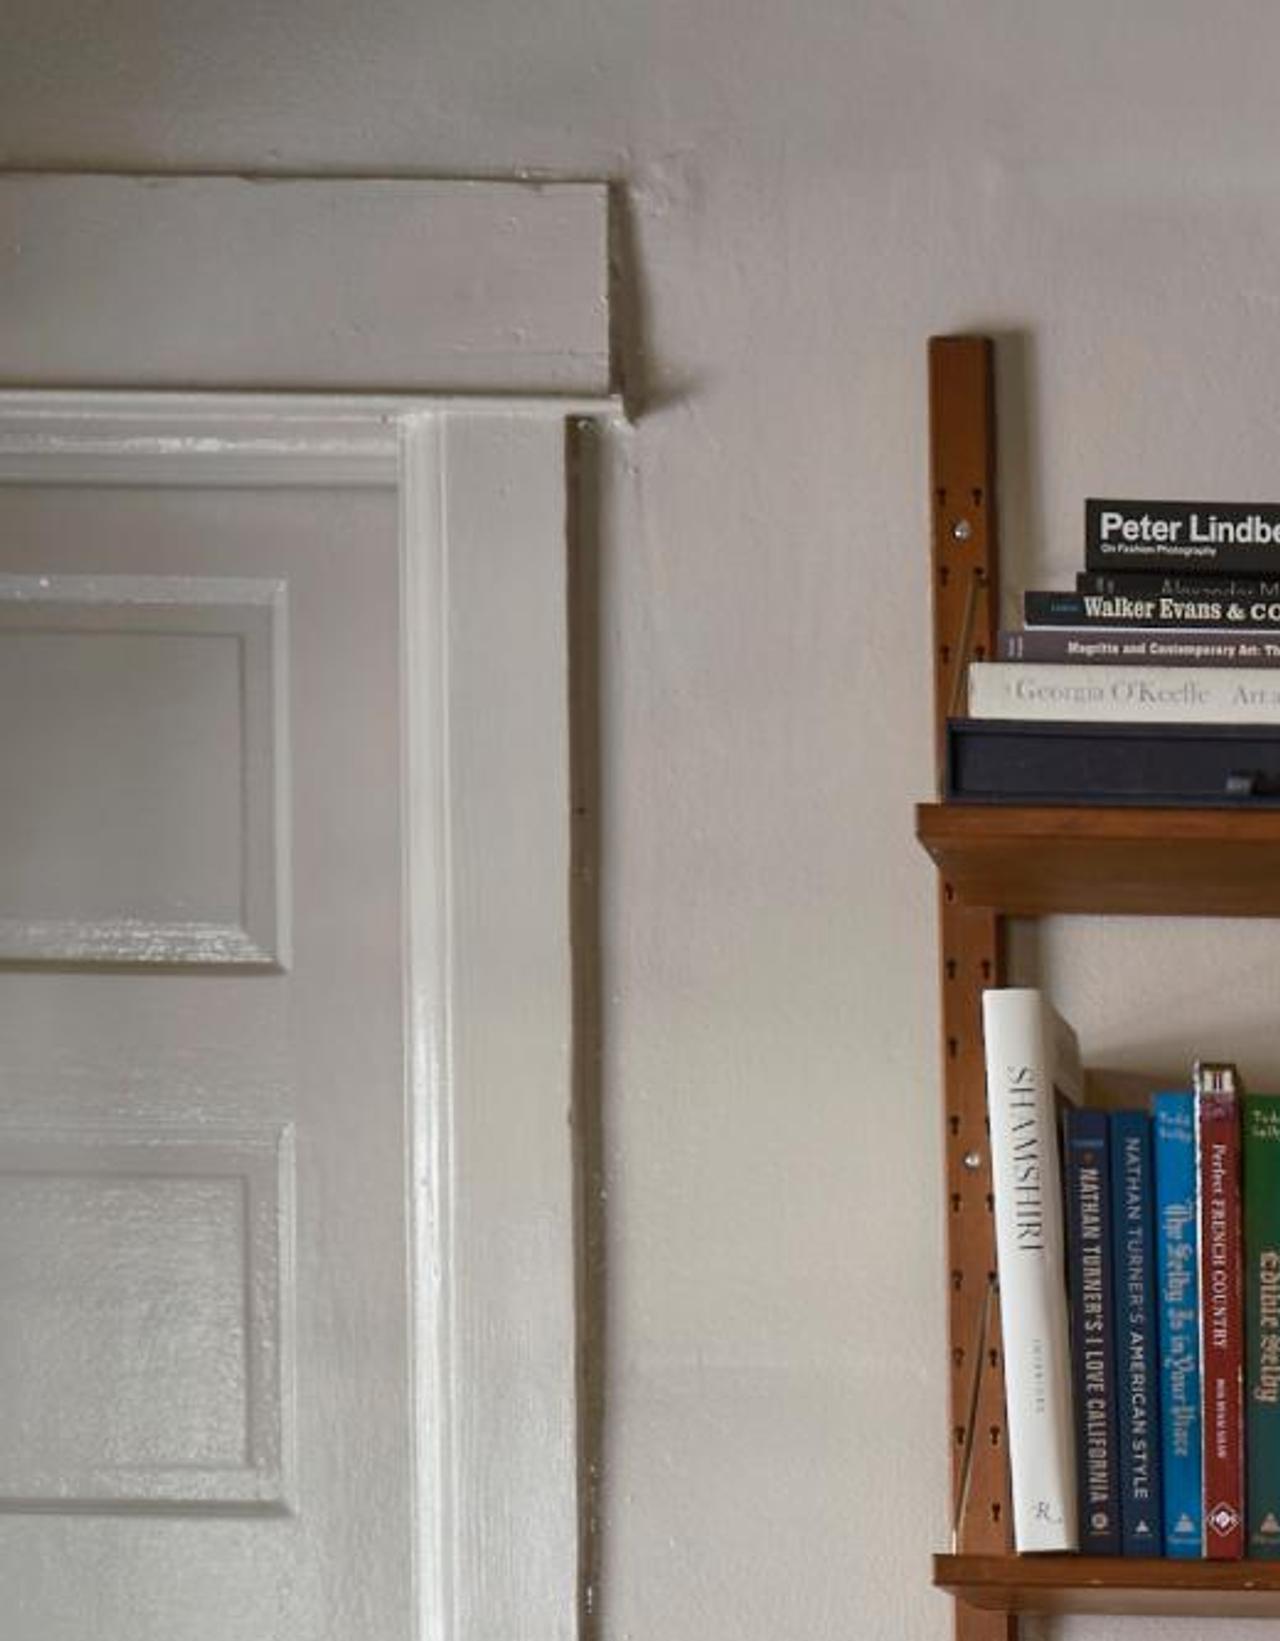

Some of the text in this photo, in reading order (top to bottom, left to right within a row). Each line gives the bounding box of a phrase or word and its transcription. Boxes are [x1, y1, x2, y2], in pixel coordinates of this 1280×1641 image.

[1100, 511, 1181, 541] Peter
[1083, 596, 1153, 619] Walker
[1159, 597, 1222, 620] Evans
[1226, 604, 1244, 620] &
[1067, 641, 1118, 657] Magritte
[1122, 642, 1146, 656] and
[1149, 642, 1237, 660] Contemporary
[1015, 679, 1104, 706] Georgia
[1230, 685, 1268, 706] Art
[1006, 1063, 1045, 1254] SHAMSHIRI
[1079, 1166, 1101, 1240] NATHAN
[1210, 1144, 1229, 1348] Perfect FRENCH COUNTRY
[1081, 1244, 1103, 1331] TURNER'S
[1124, 1138, 1149, 1499] NATHAN TURNER'S AMERICAN STYLE
[1084, 1346, 1105, 1396] LOVE
[1086, 1398, 1108, 1503] CALIFORNIA
